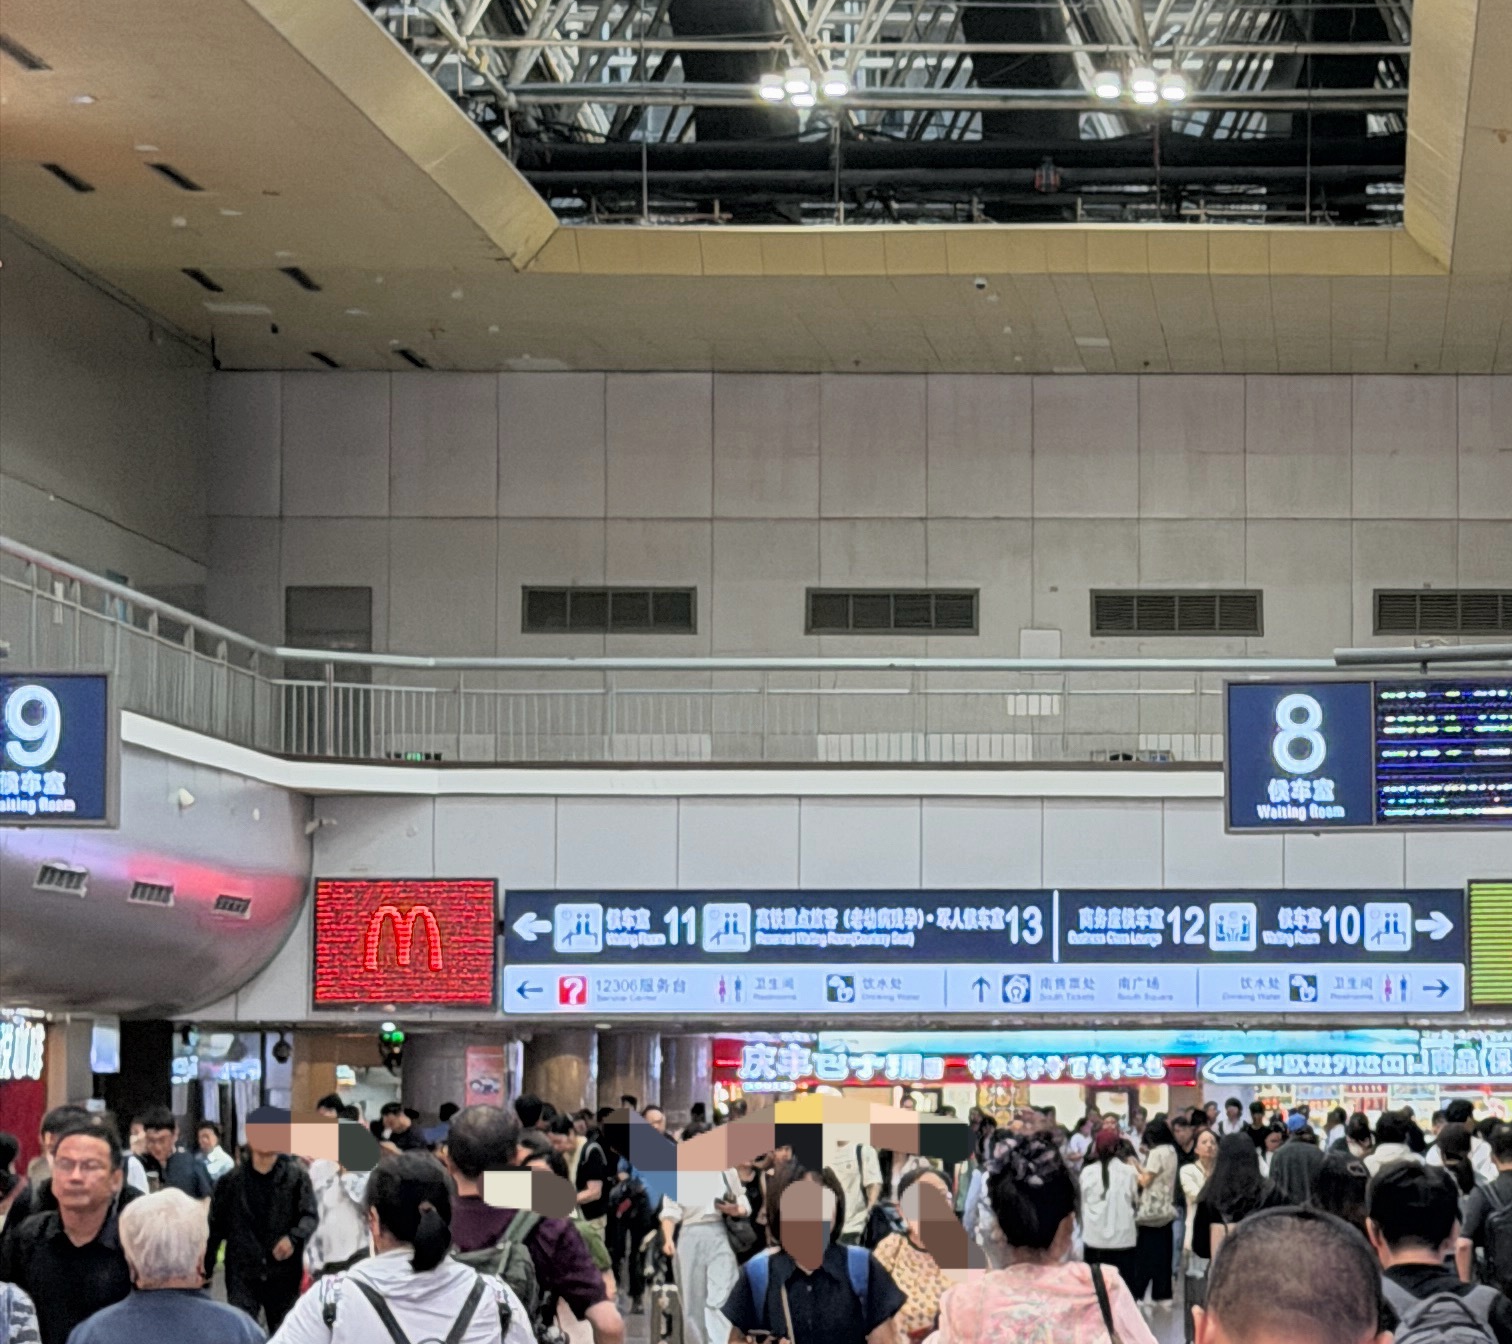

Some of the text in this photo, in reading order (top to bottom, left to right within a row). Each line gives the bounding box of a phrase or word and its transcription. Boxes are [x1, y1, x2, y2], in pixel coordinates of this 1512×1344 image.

[5, 684, 61, 767] 9
[1272, 693, 1327, 774] 8
[1268, 777, 1335, 803] 候车室
[1256, 804, 1307, 821] Waiting
[664, 906, 696, 945] 11
[1005, 905, 1043, 945] 13
[1166, 905, 1205, 945] 12
[1323, 905, 1361, 945] 10
